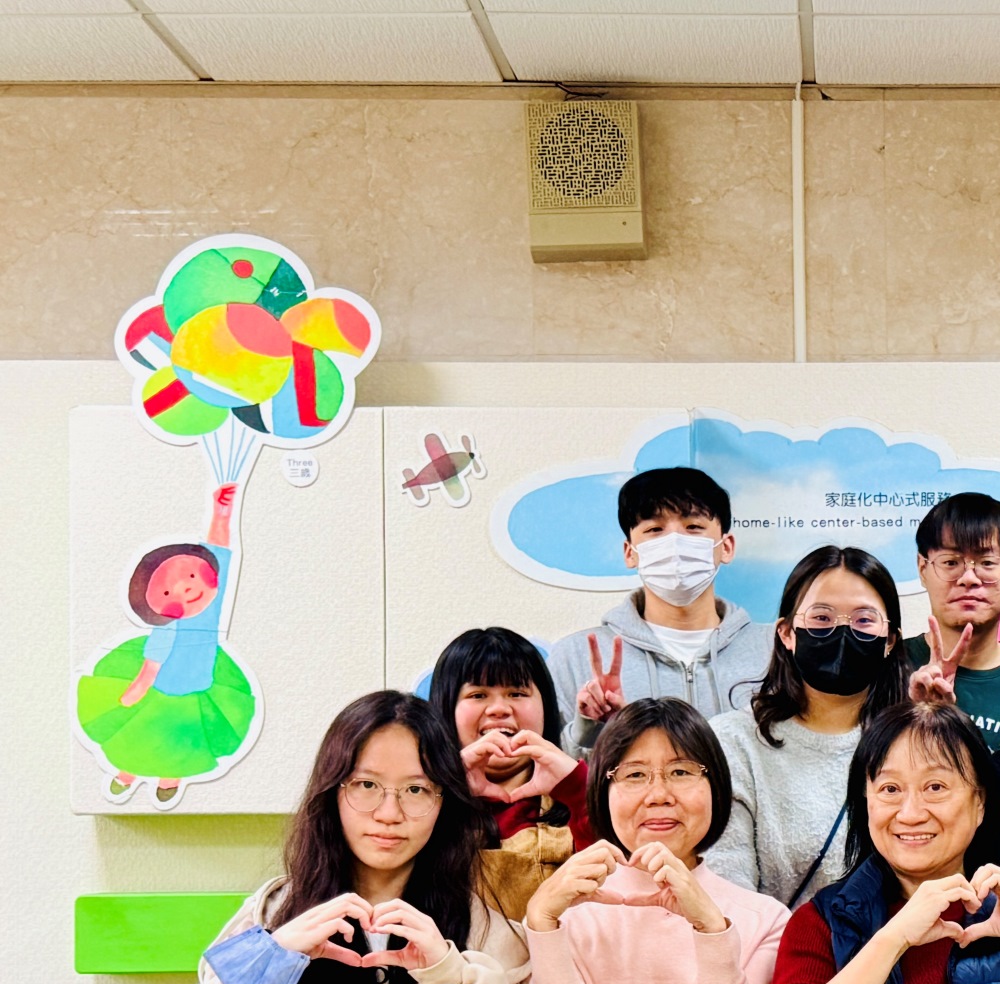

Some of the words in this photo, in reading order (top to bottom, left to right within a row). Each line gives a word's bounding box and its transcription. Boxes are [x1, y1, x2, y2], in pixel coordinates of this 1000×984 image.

[287, 459, 313, 467] Three
[733, 516, 805, 528] home-like
[811, 516, 903, 528] center-based
